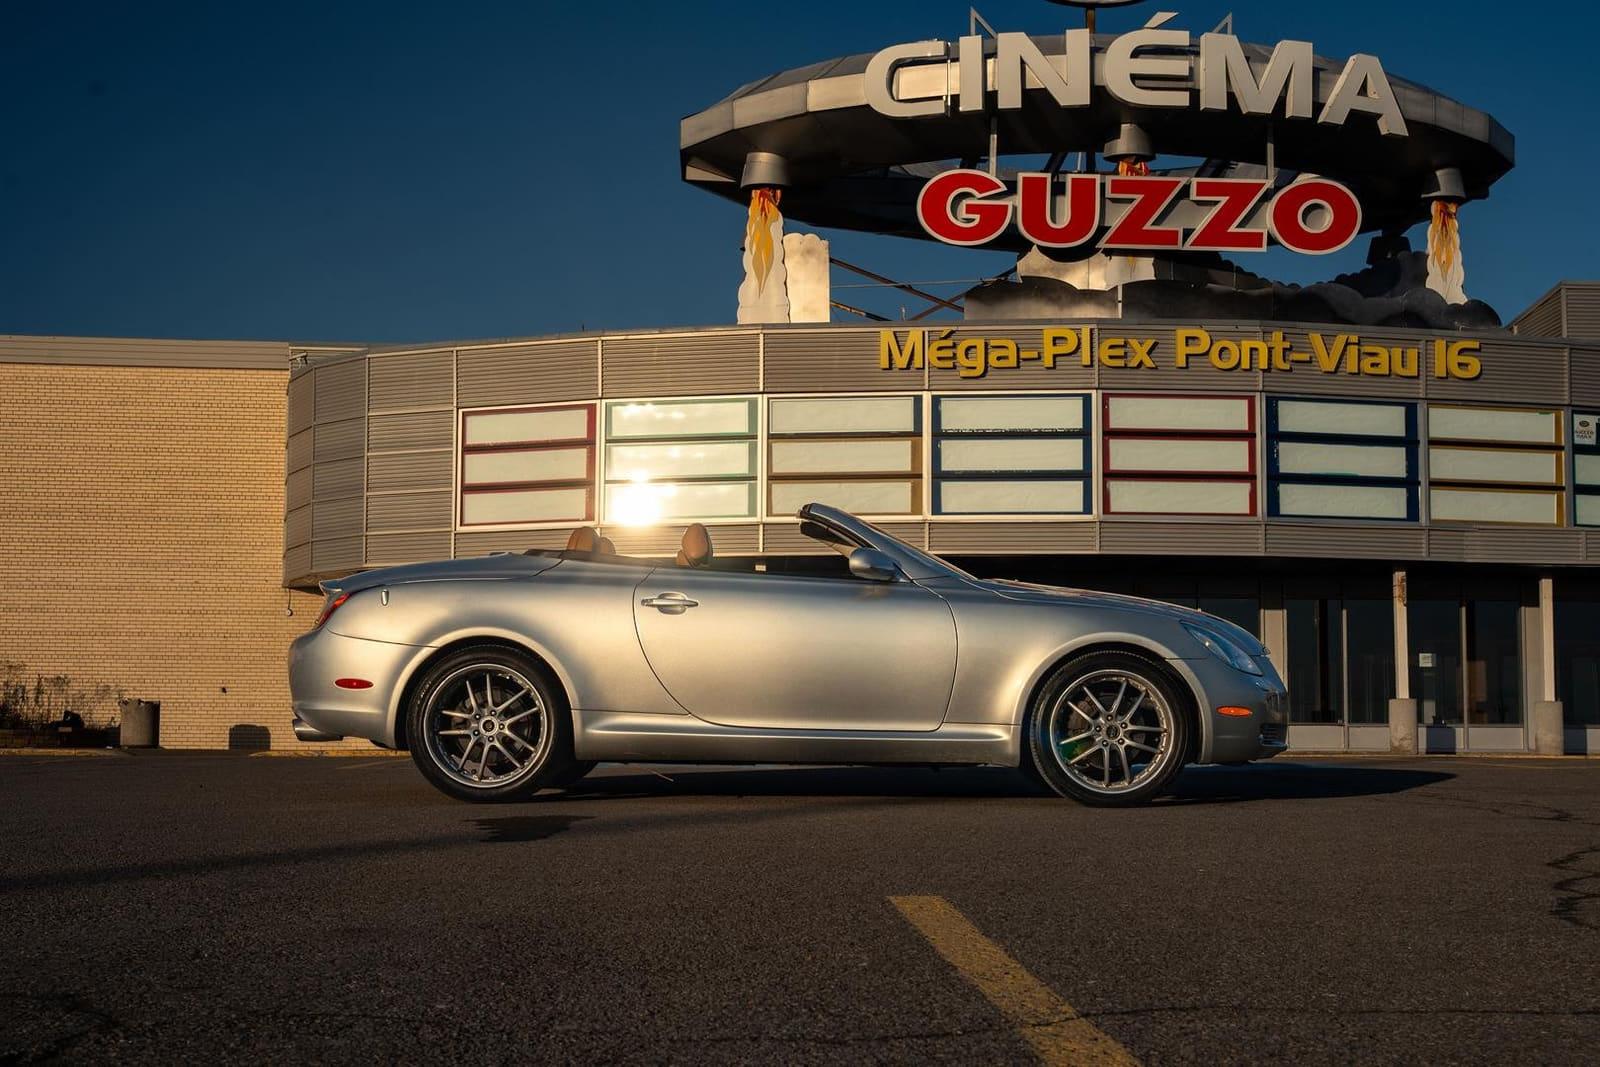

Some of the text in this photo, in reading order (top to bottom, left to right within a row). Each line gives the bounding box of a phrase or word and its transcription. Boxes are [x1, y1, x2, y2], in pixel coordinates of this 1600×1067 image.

[864, 12, 1409, 136] CINÉMA
[917, 169, 1362, 255] GUZZO
[880, 327, 1482, 379] Méga-Plex Pont-Viau 16
